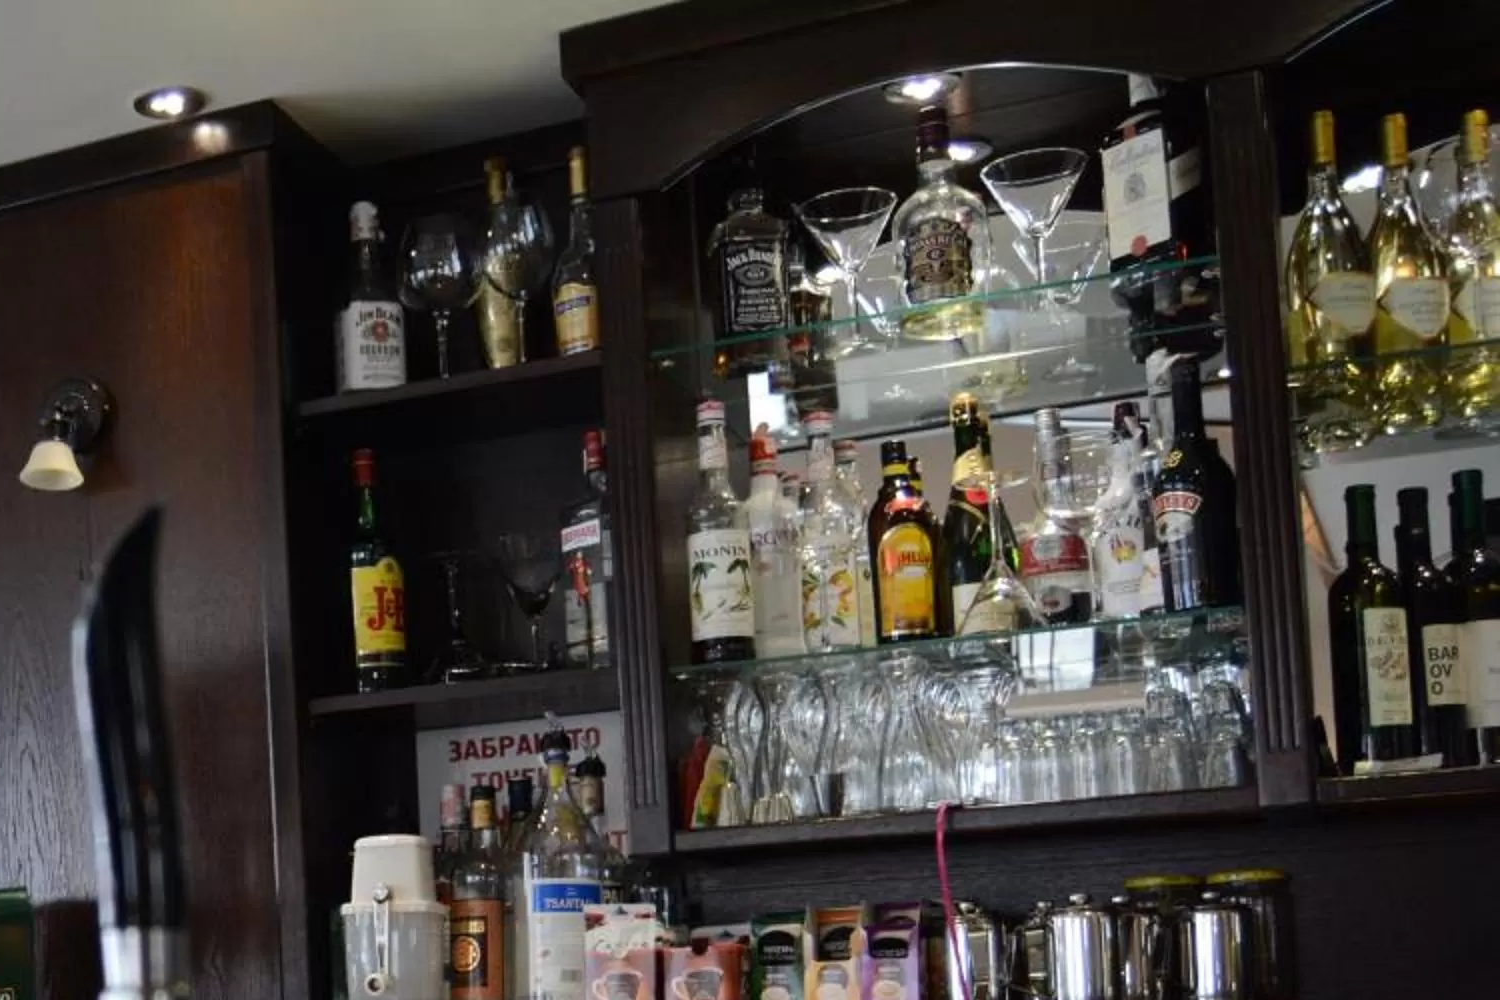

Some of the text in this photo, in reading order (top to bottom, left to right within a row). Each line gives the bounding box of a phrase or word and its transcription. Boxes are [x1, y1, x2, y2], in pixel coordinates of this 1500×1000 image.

[693, 545, 747, 559] MONIN
[1427, 646, 1460, 661] BAR
[1430, 664, 1453, 678] OV
[1431, 681, 1445, 695] O
